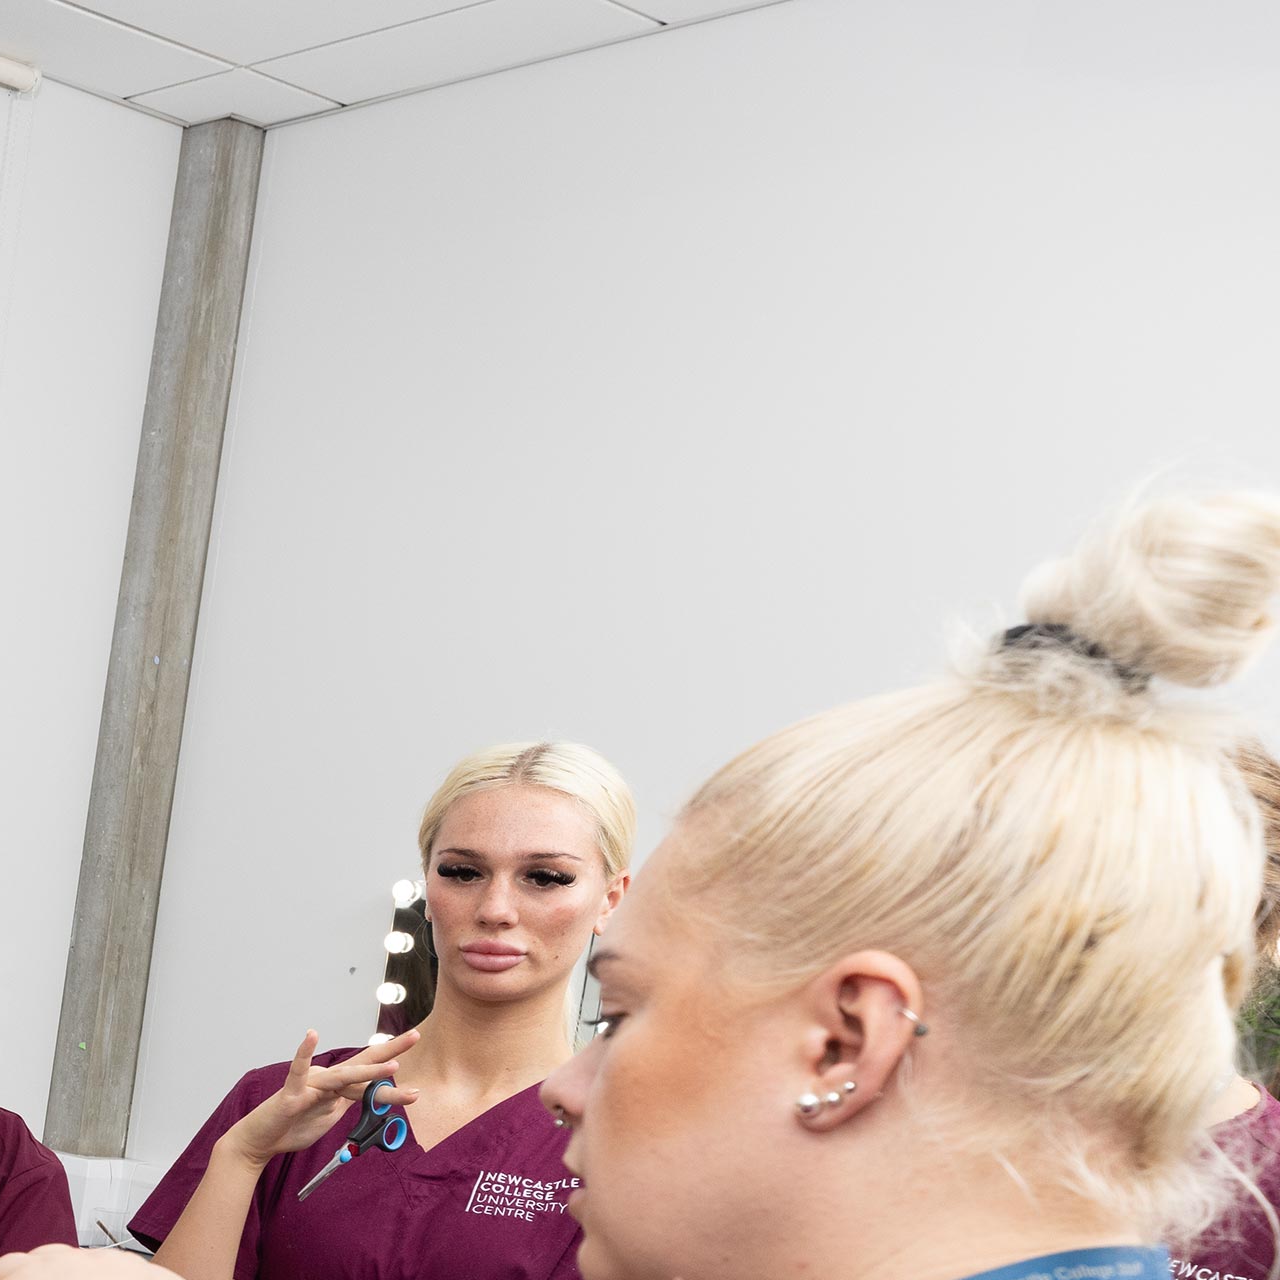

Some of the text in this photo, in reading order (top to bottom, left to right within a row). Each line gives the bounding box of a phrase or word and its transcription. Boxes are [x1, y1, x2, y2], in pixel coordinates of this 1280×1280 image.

[484, 1172, 580, 1190] NEWCASTLE
[480, 1182, 556, 1201] COLLEGE
[476, 1193, 568, 1214] UNIVERSITY
[471, 1204, 536, 1222] CENTRE
